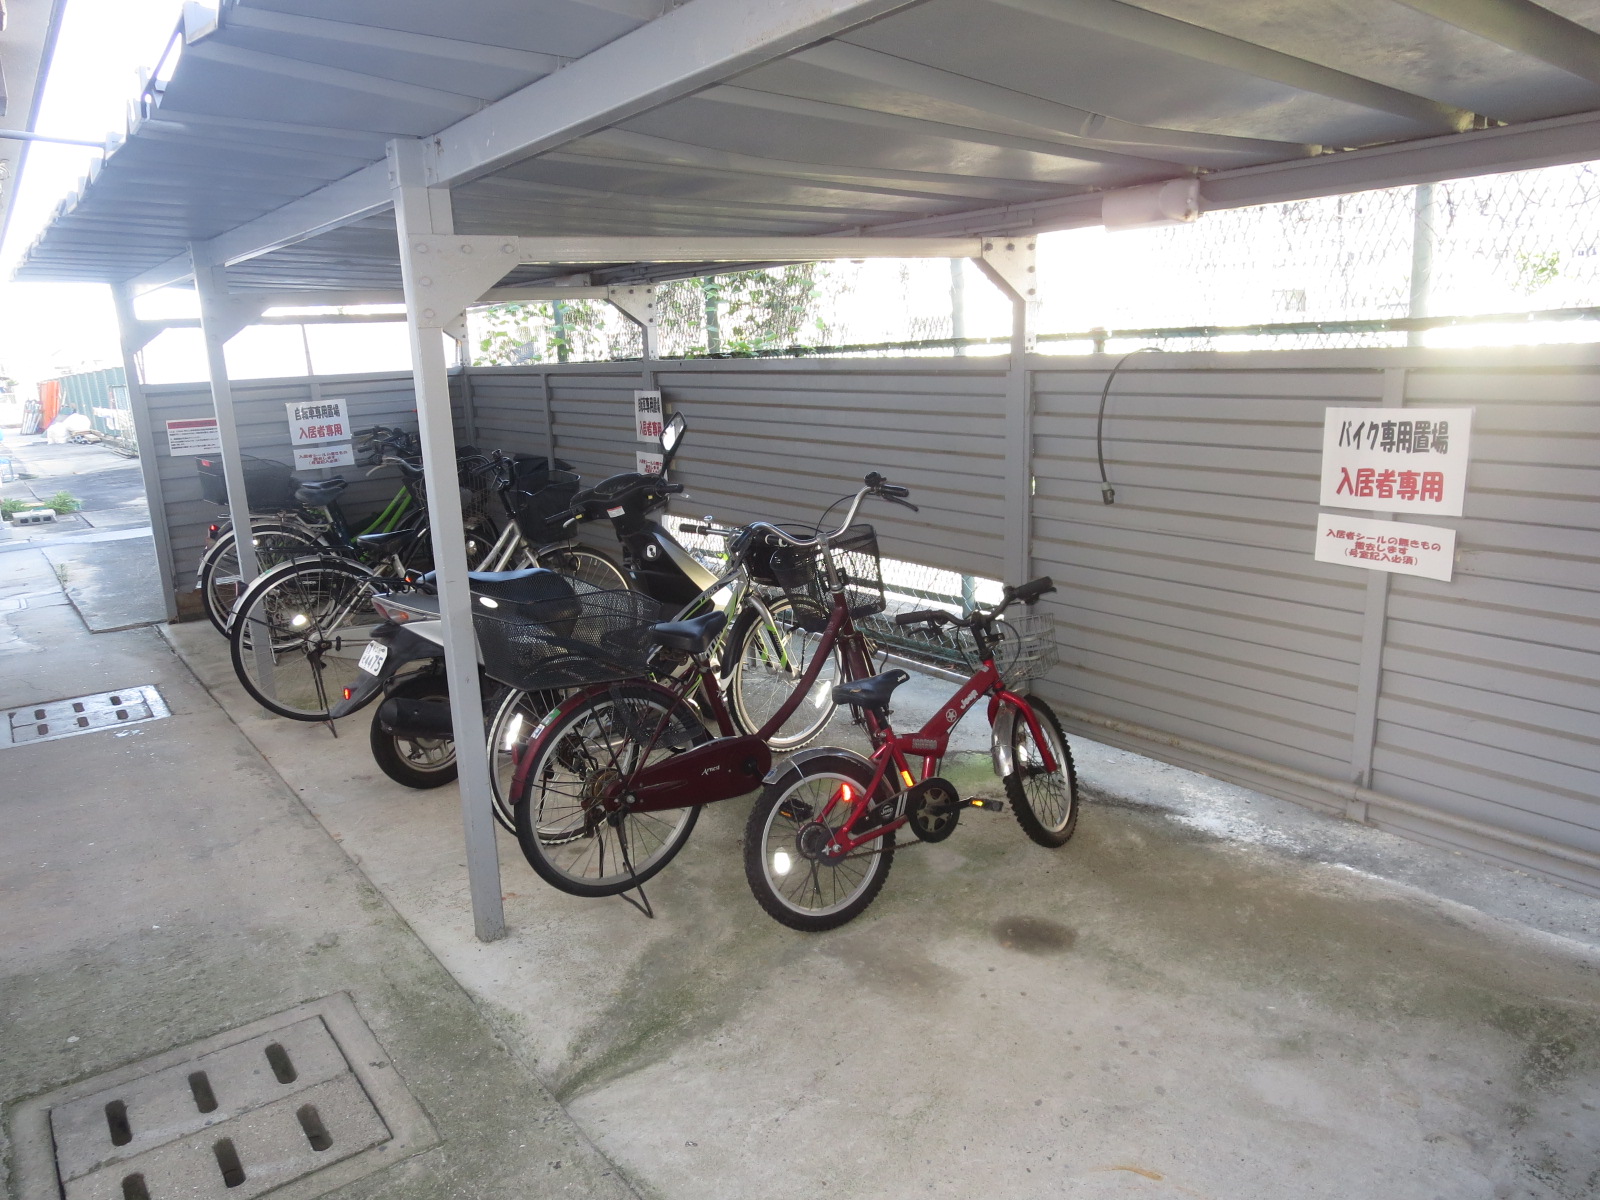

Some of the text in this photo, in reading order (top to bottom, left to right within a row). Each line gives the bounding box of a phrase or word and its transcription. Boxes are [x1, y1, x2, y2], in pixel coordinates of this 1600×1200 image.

[294, 404, 341, 421] 自転車専用置場
[299, 423, 343, 440] 入居者専用
[1338, 420, 1449, 455] バイク専用置場
[1336, 466, 1445, 503] 入居者専用
[1326, 528, 1441, 552] 入居者シールの無きもの
[1355, 541, 1409, 555] 撤去します
[364, 654, 384, 673] 4475
[960, 689, 978, 709] Jeep
